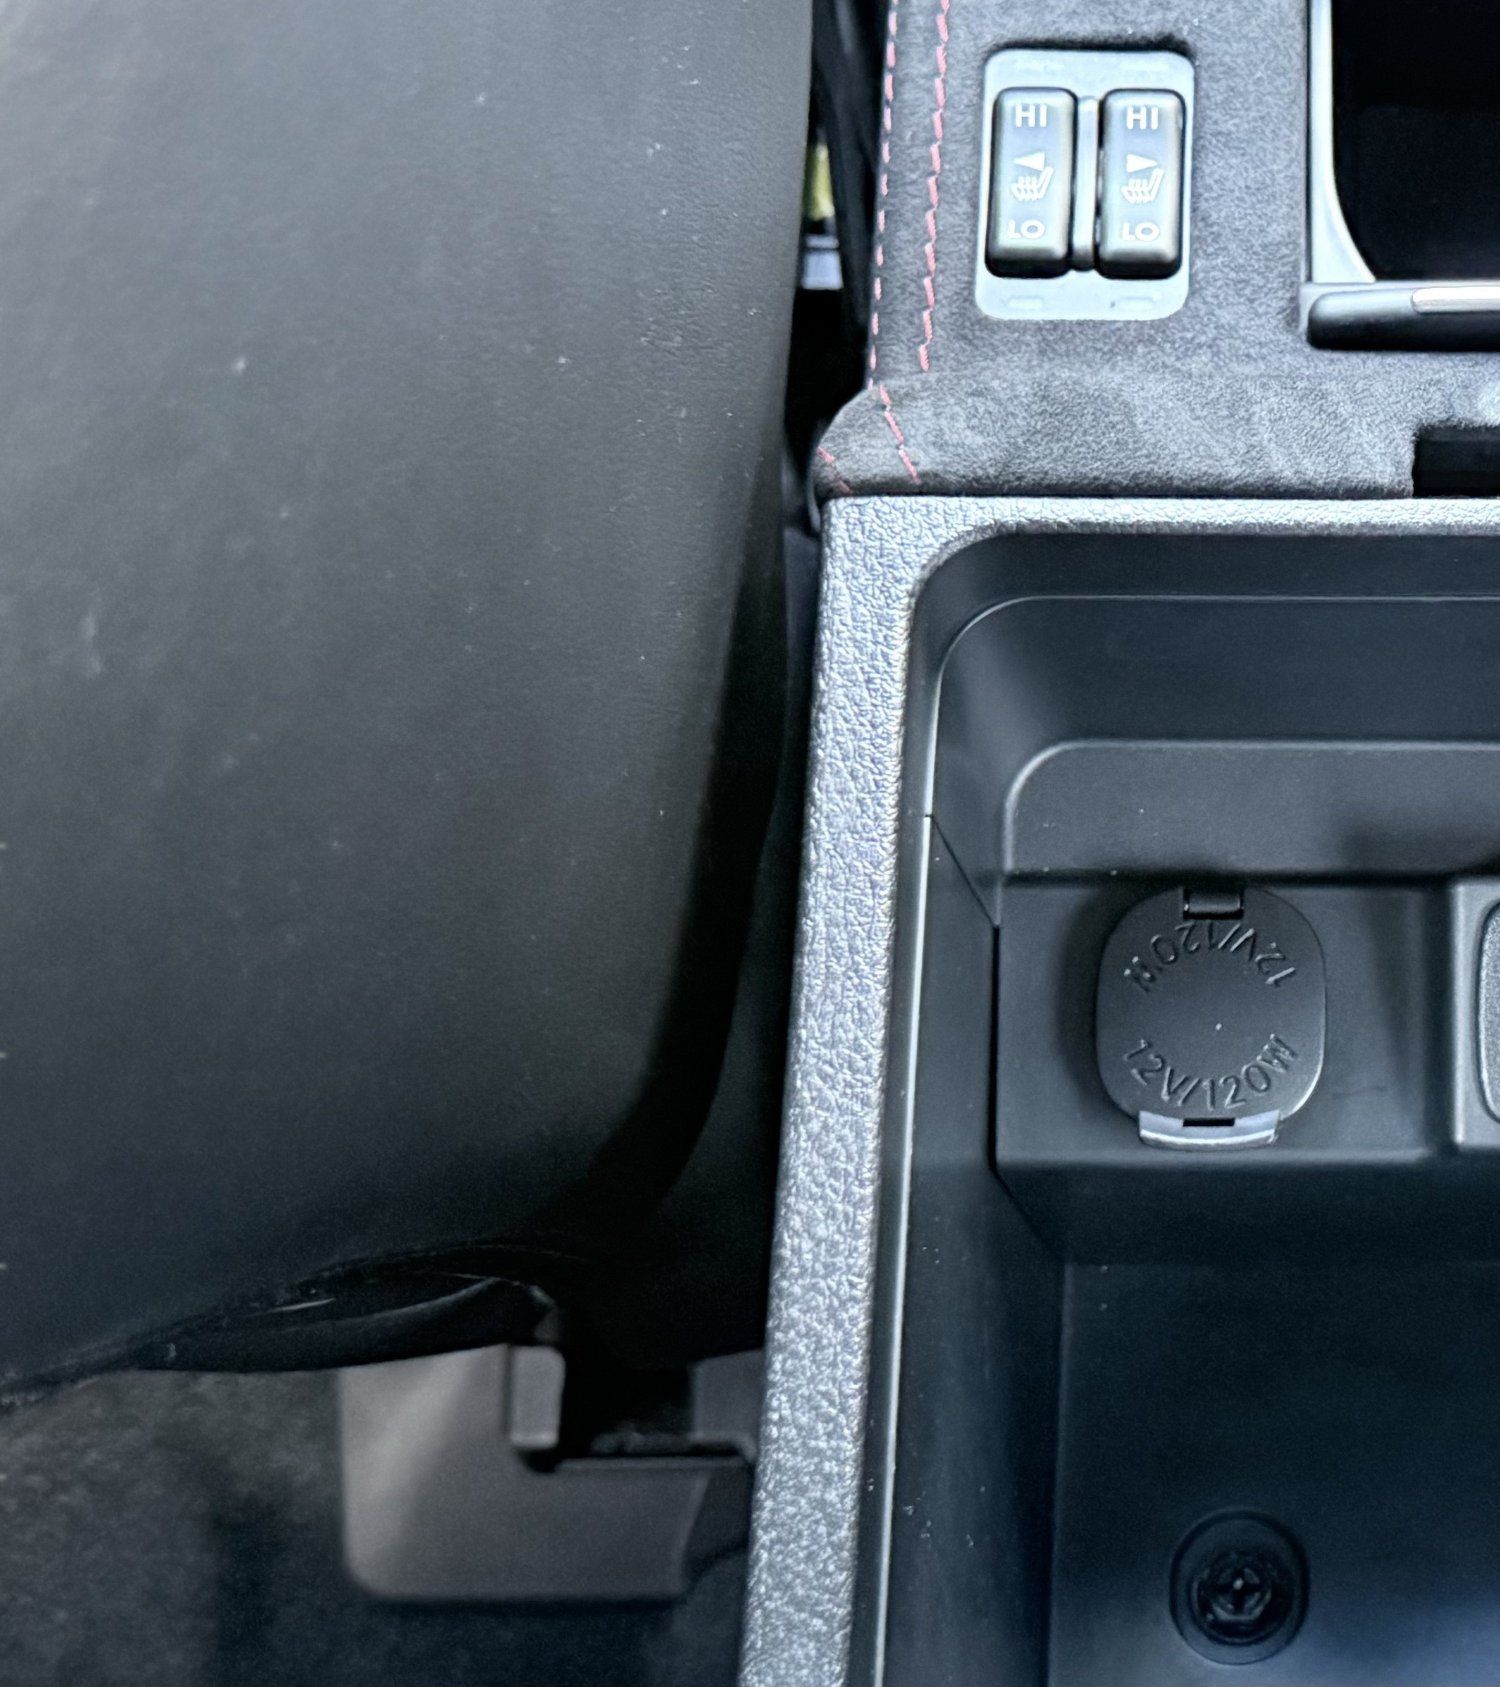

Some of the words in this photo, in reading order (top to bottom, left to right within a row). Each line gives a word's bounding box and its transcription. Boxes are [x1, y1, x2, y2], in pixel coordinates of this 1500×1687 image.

[1015, 104, 1047, 127] HI
[1126, 107, 1159, 130] HI
[1007, 220, 1045, 239] LO
[1122, 222, 1160, 241] LO
[1123, 1033, 1298, 1111] 12V/120W
